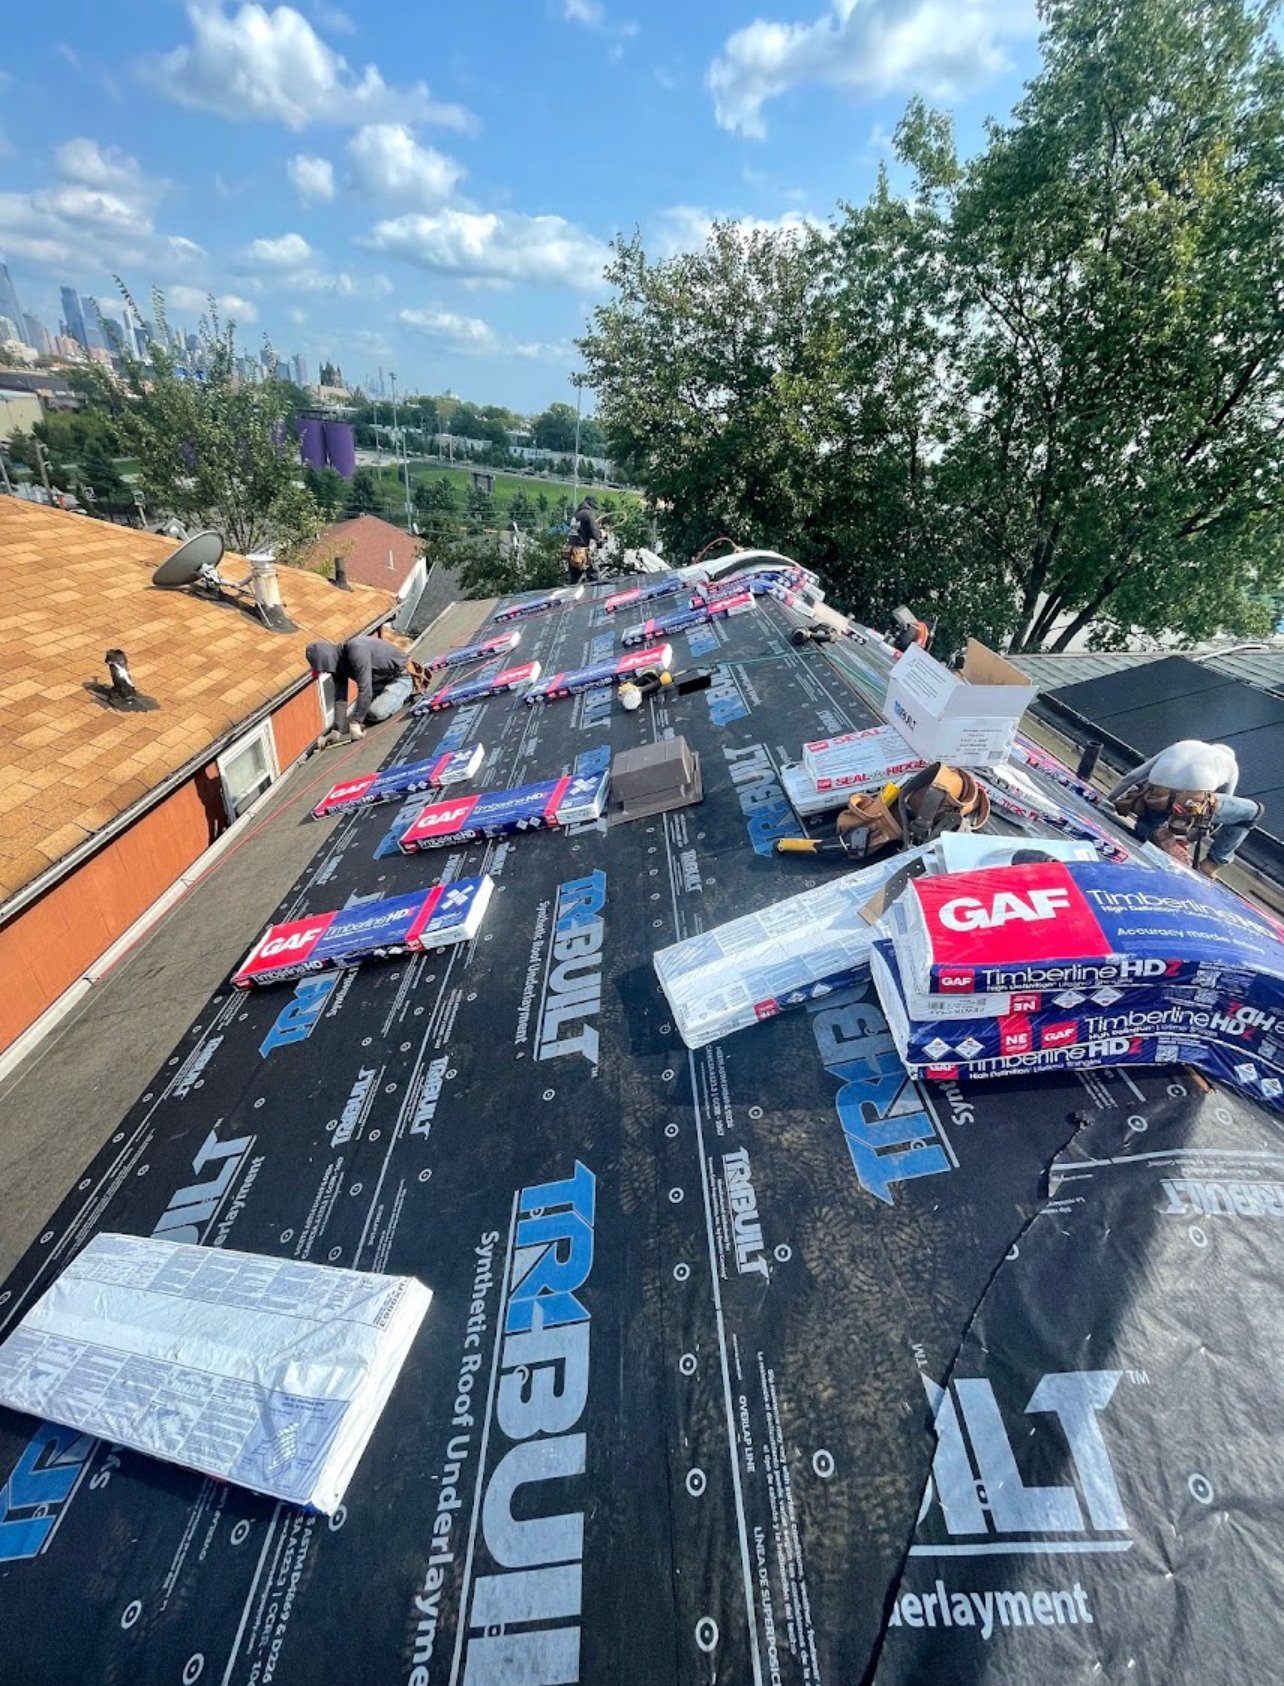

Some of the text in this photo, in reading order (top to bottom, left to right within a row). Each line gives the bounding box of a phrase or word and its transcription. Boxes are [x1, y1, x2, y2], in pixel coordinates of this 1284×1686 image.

[329, 780, 372, 799] GAF
[417, 805, 470, 829] GAF
[938, 887, 1071, 932] GAF
[260, 927, 323, 959] GAF
[941, 976, 973, 987] GAF
[514, 963, 540, 1045] Underlayment
[1004, 1032, 1028, 1046] NE
[1043, 1027, 1076, 1042] GAF
[721, 1145, 770, 1285] TRIBUILT
[464, 1230, 500, 1349] Synthetic
[451, 1353, 483, 1427] Roof
[1125, 1370, 1151, 1385] TM
[739, 1394, 753, 1447] OVERLAP
[744, 1446, 756, 1473] LINE
[292, 1527, 315, 1571] ASTM
[752, 1525, 768, 1567] LÍNEA
[278, 1569, 302, 1622] D4869
[757, 1567, 768, 1586] DE
[260, 1636, 284, 1685] D226
